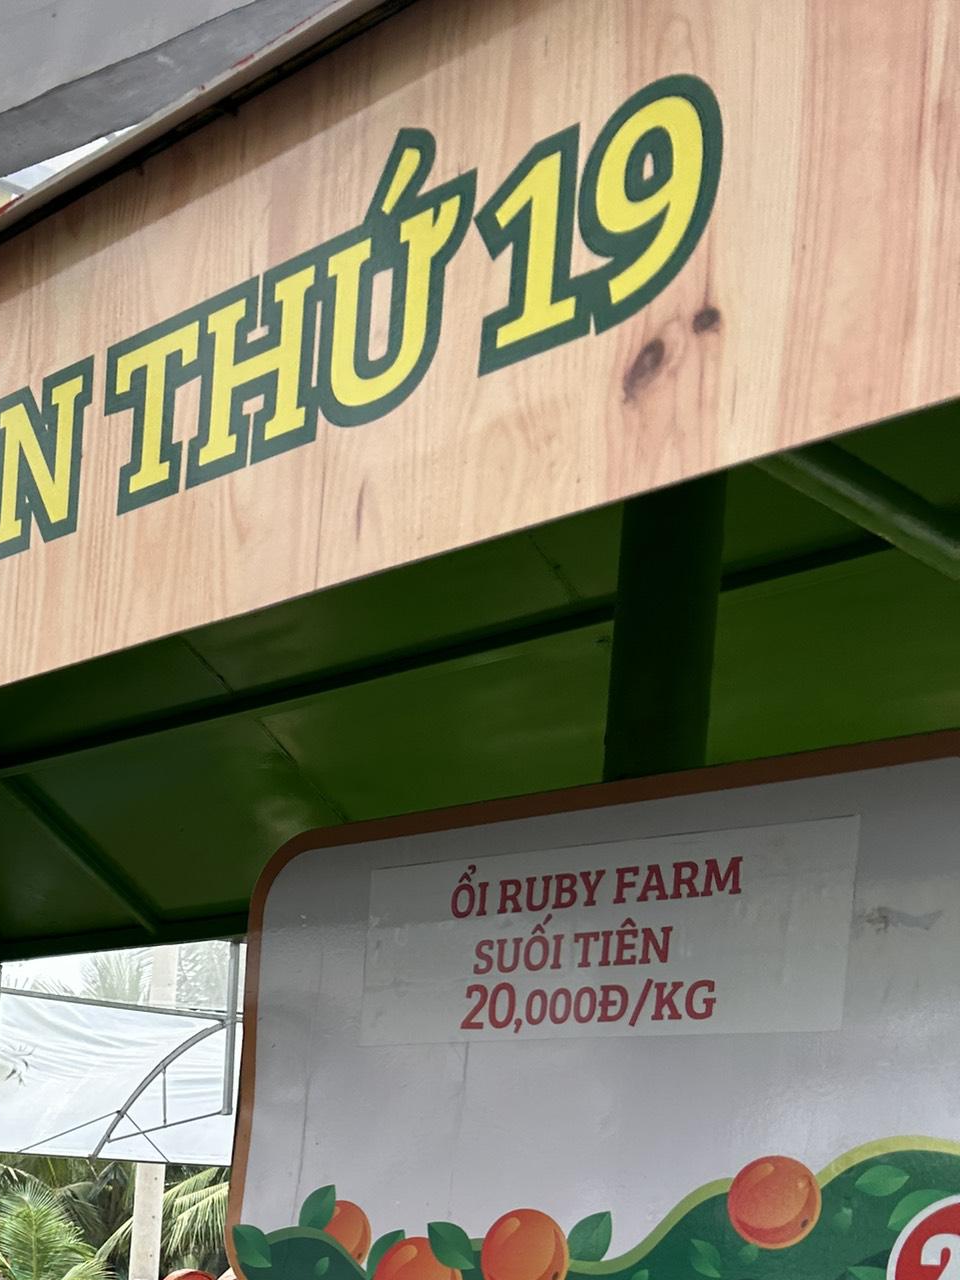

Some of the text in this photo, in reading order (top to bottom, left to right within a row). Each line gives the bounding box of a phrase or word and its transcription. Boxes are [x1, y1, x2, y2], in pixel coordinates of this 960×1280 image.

[104, 127, 477, 517] THỨ
[474, 73, 724, 378] 19
[450, 856, 743, 919] ỔI RUBY FARM
[473, 913, 673, 976] SUỐI TIÊN
[460, 978, 717, 1034] 20,000Đ/KG
